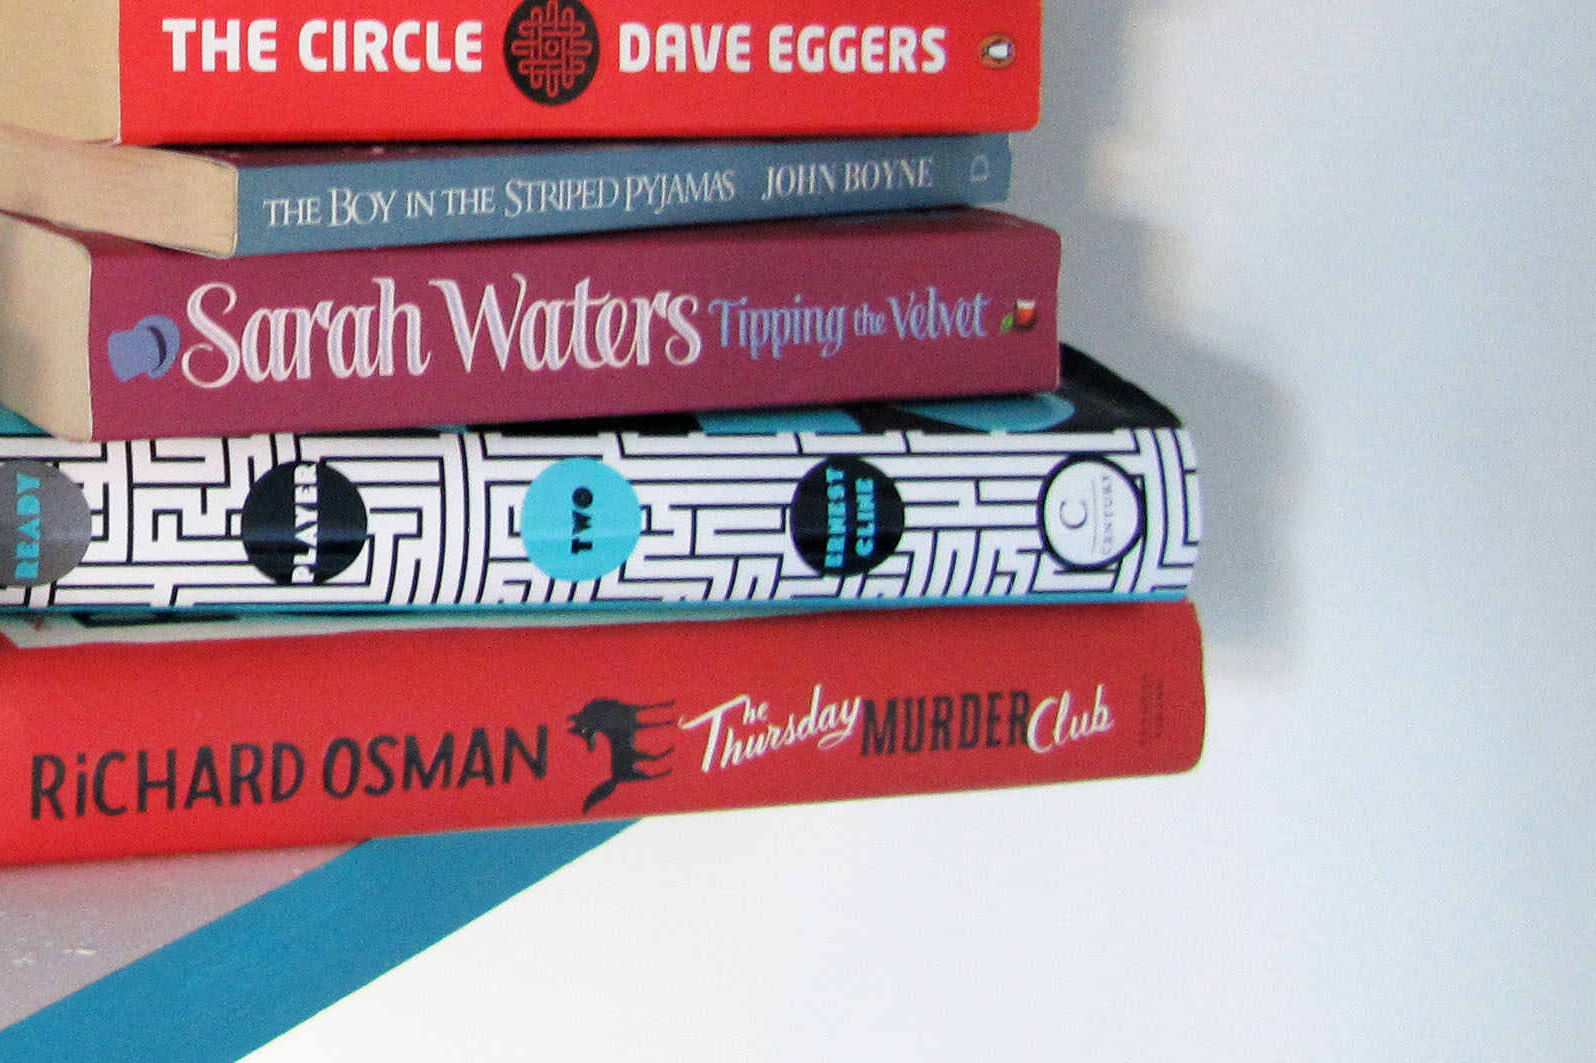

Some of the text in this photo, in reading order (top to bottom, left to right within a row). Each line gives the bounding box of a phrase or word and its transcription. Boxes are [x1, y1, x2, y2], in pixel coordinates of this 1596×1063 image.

[162, 18, 484, 73] THE CIRCLE
[618, 22, 946, 74] DAVE EGGERS
[263, 170, 736, 229] THE BOY IN THE STRIPED PYJAMAS
[761, 157, 934, 201] JOHN BOYNE
[181, 272, 704, 388] Sarah Waters
[708, 287, 992, 361] Tipping the Velvet
[14, 473, 42, 580] READY
[291, 463, 319, 584] PLAYER
[571, 486, 594, 554] TWO
[854, 477, 877, 558] CLINE
[861, 689, 1031, 758] MURDER
[1026, 683, 1115, 754] Club
[322, 726, 549, 799] OSMAN
